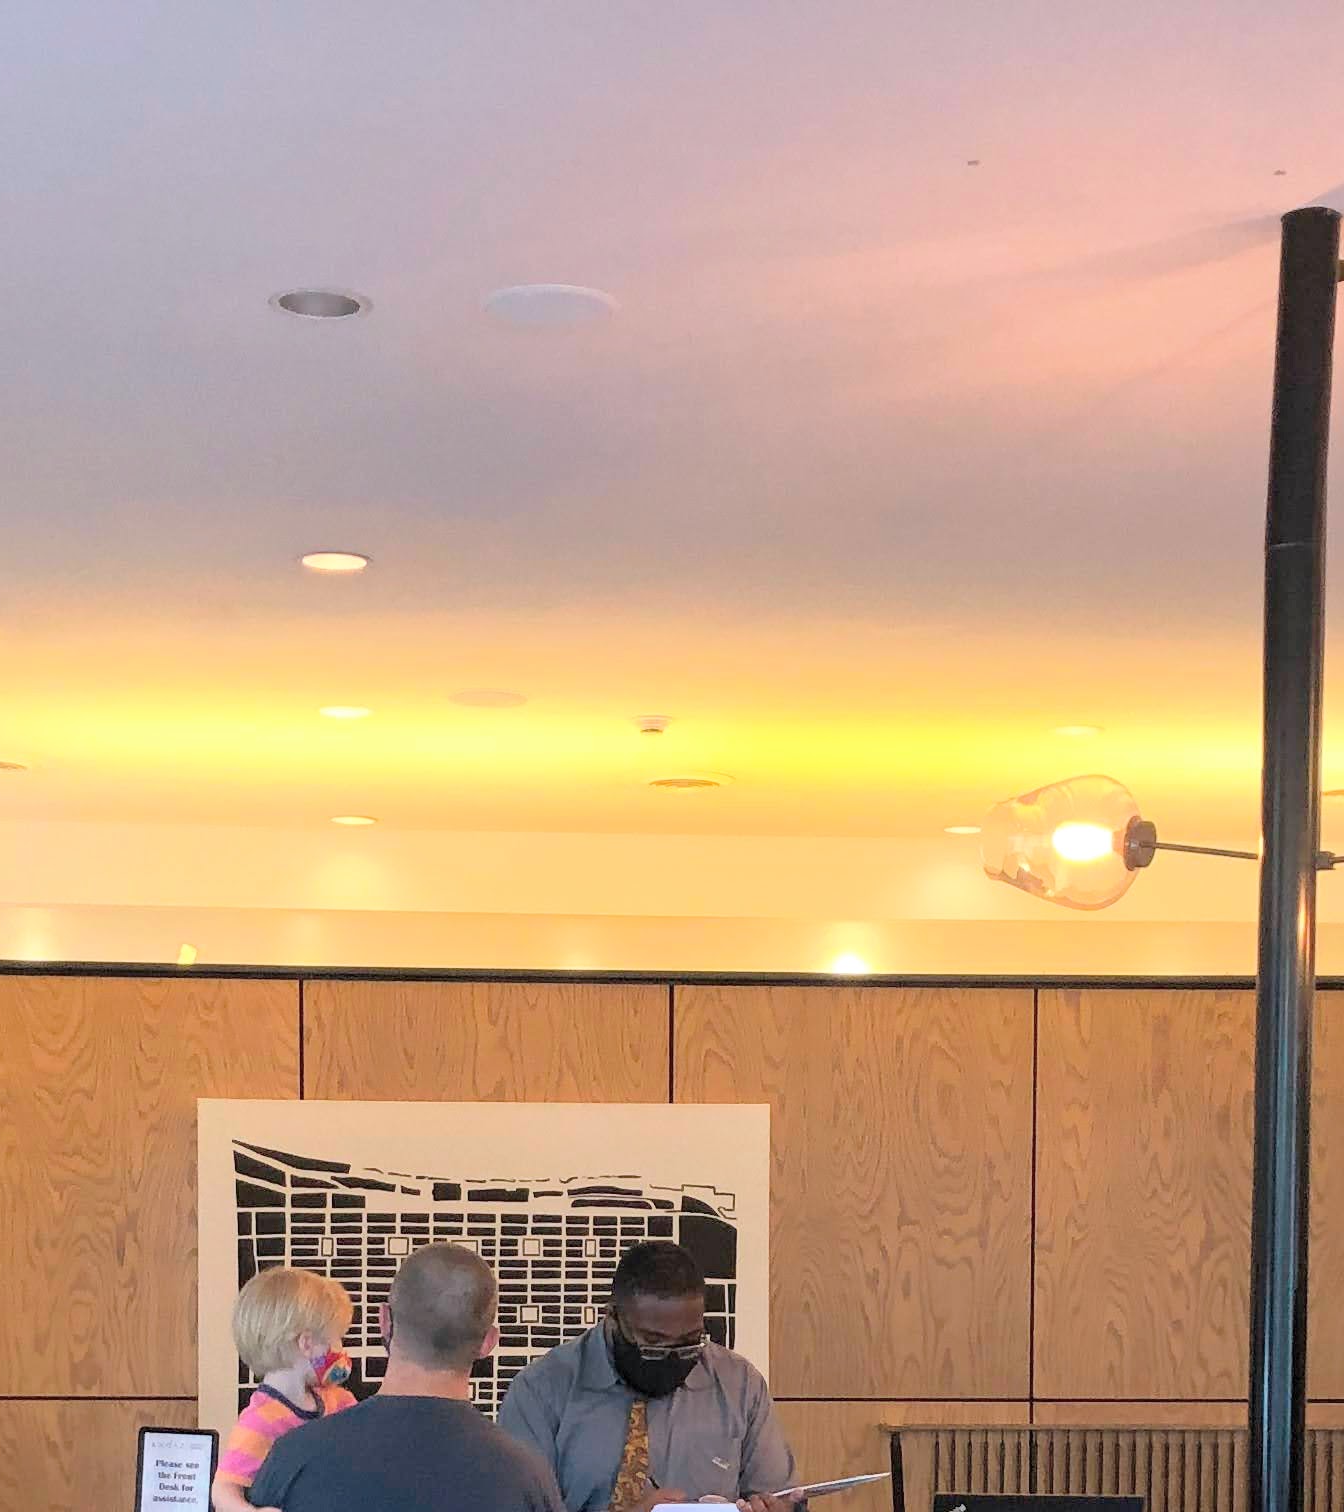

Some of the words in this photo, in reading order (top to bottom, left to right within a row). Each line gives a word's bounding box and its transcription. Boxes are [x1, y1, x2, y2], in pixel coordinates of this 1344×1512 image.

[155, 1459, 183, 1468] Please
[159, 1482, 179, 1491] Desk
[181, 1484, 194, 1492] for
